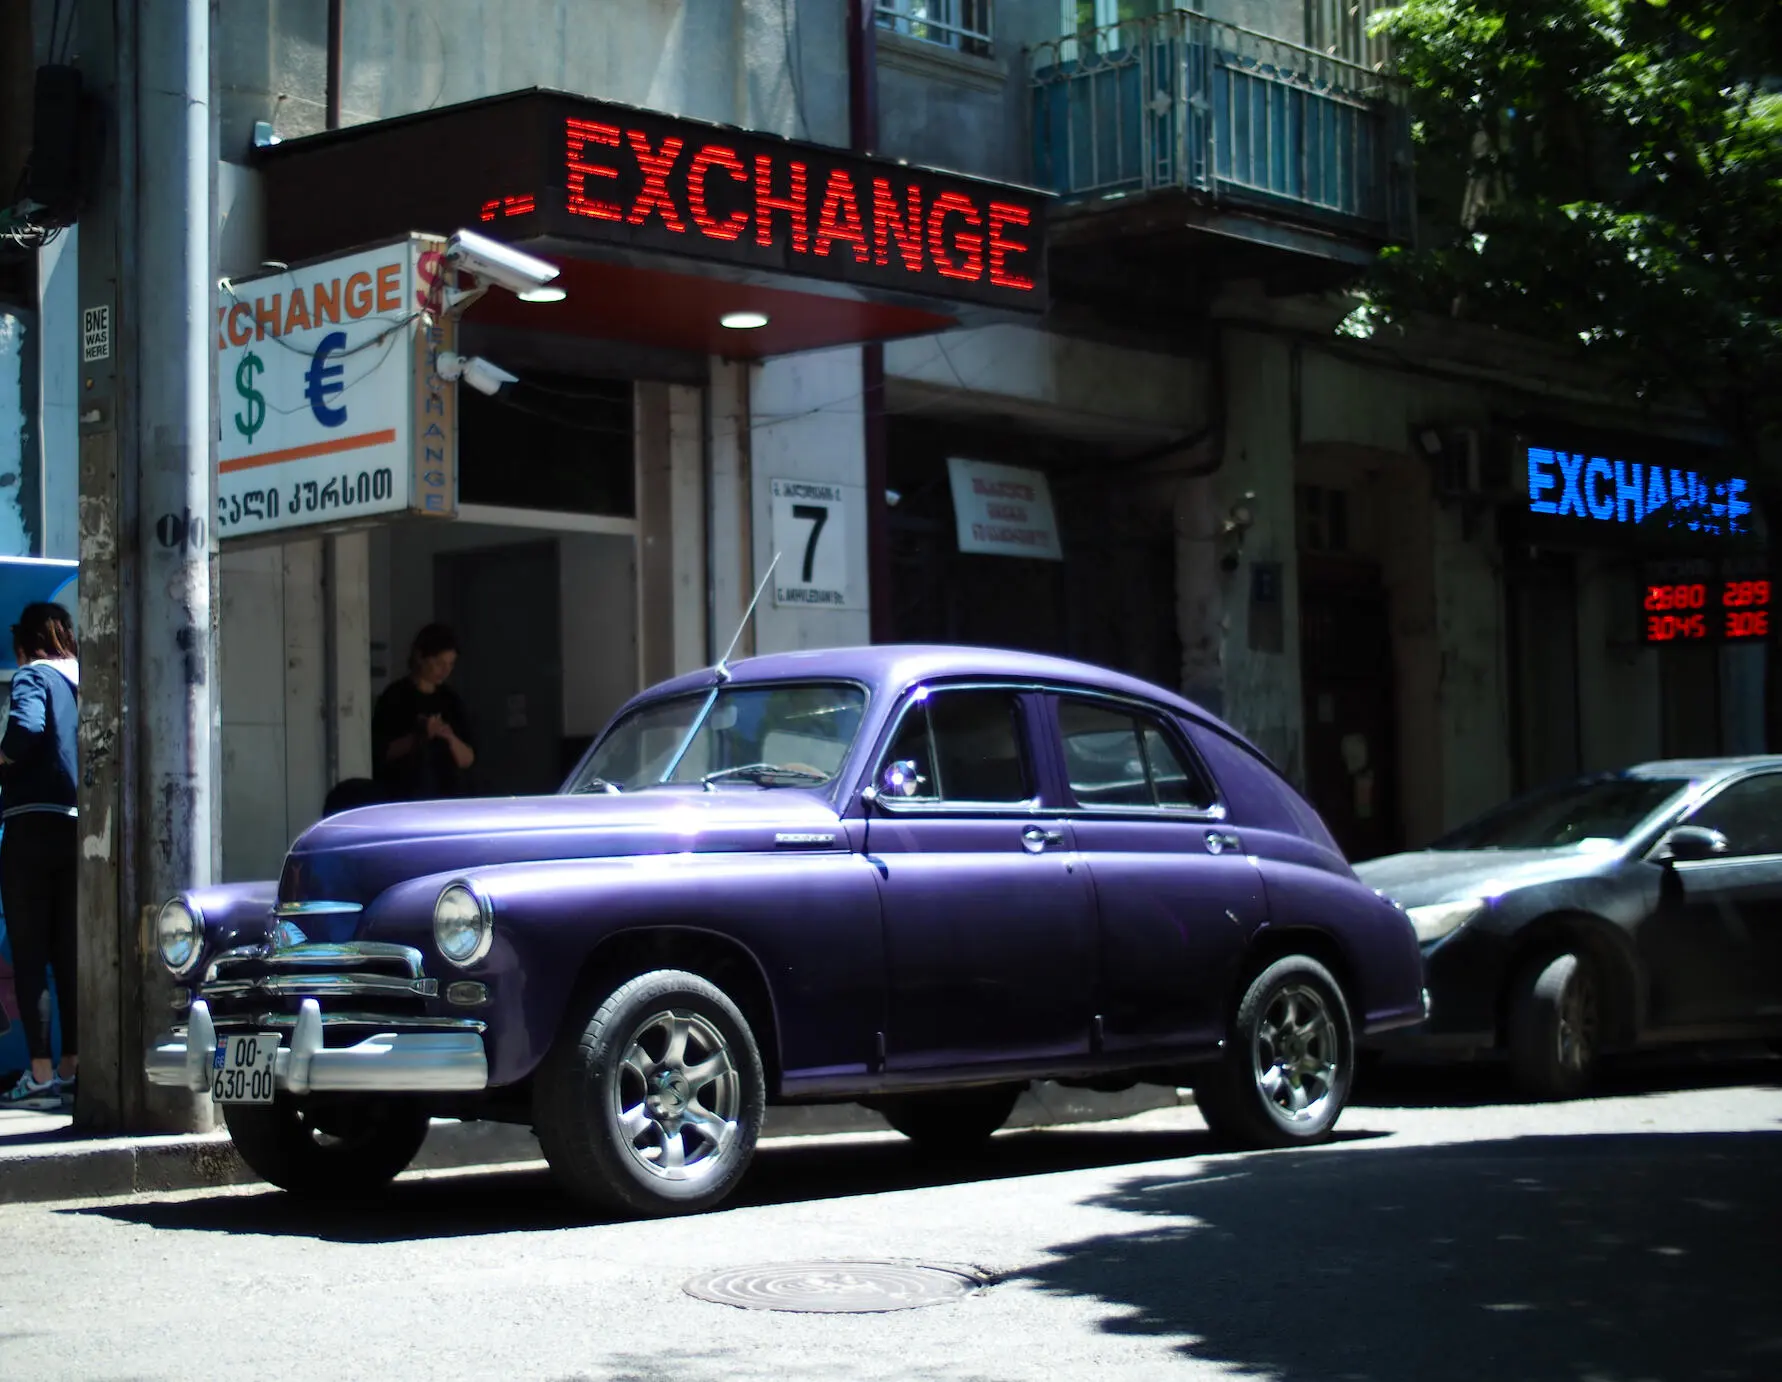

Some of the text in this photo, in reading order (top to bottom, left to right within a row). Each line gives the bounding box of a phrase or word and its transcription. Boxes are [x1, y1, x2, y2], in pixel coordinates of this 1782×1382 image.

[565, 117, 1035, 291] EXCHANGE
[86, 308, 107, 333] BNE
[86, 331, 107, 346] WAS
[86, 344, 108, 358] HERE
[234, 351, 265, 445] $
[304, 331, 348, 427] €
[288, 467, 393, 515] კურსით
[792, 504, 828, 583] 7
[214, 1069, 272, 1099] 630-00
